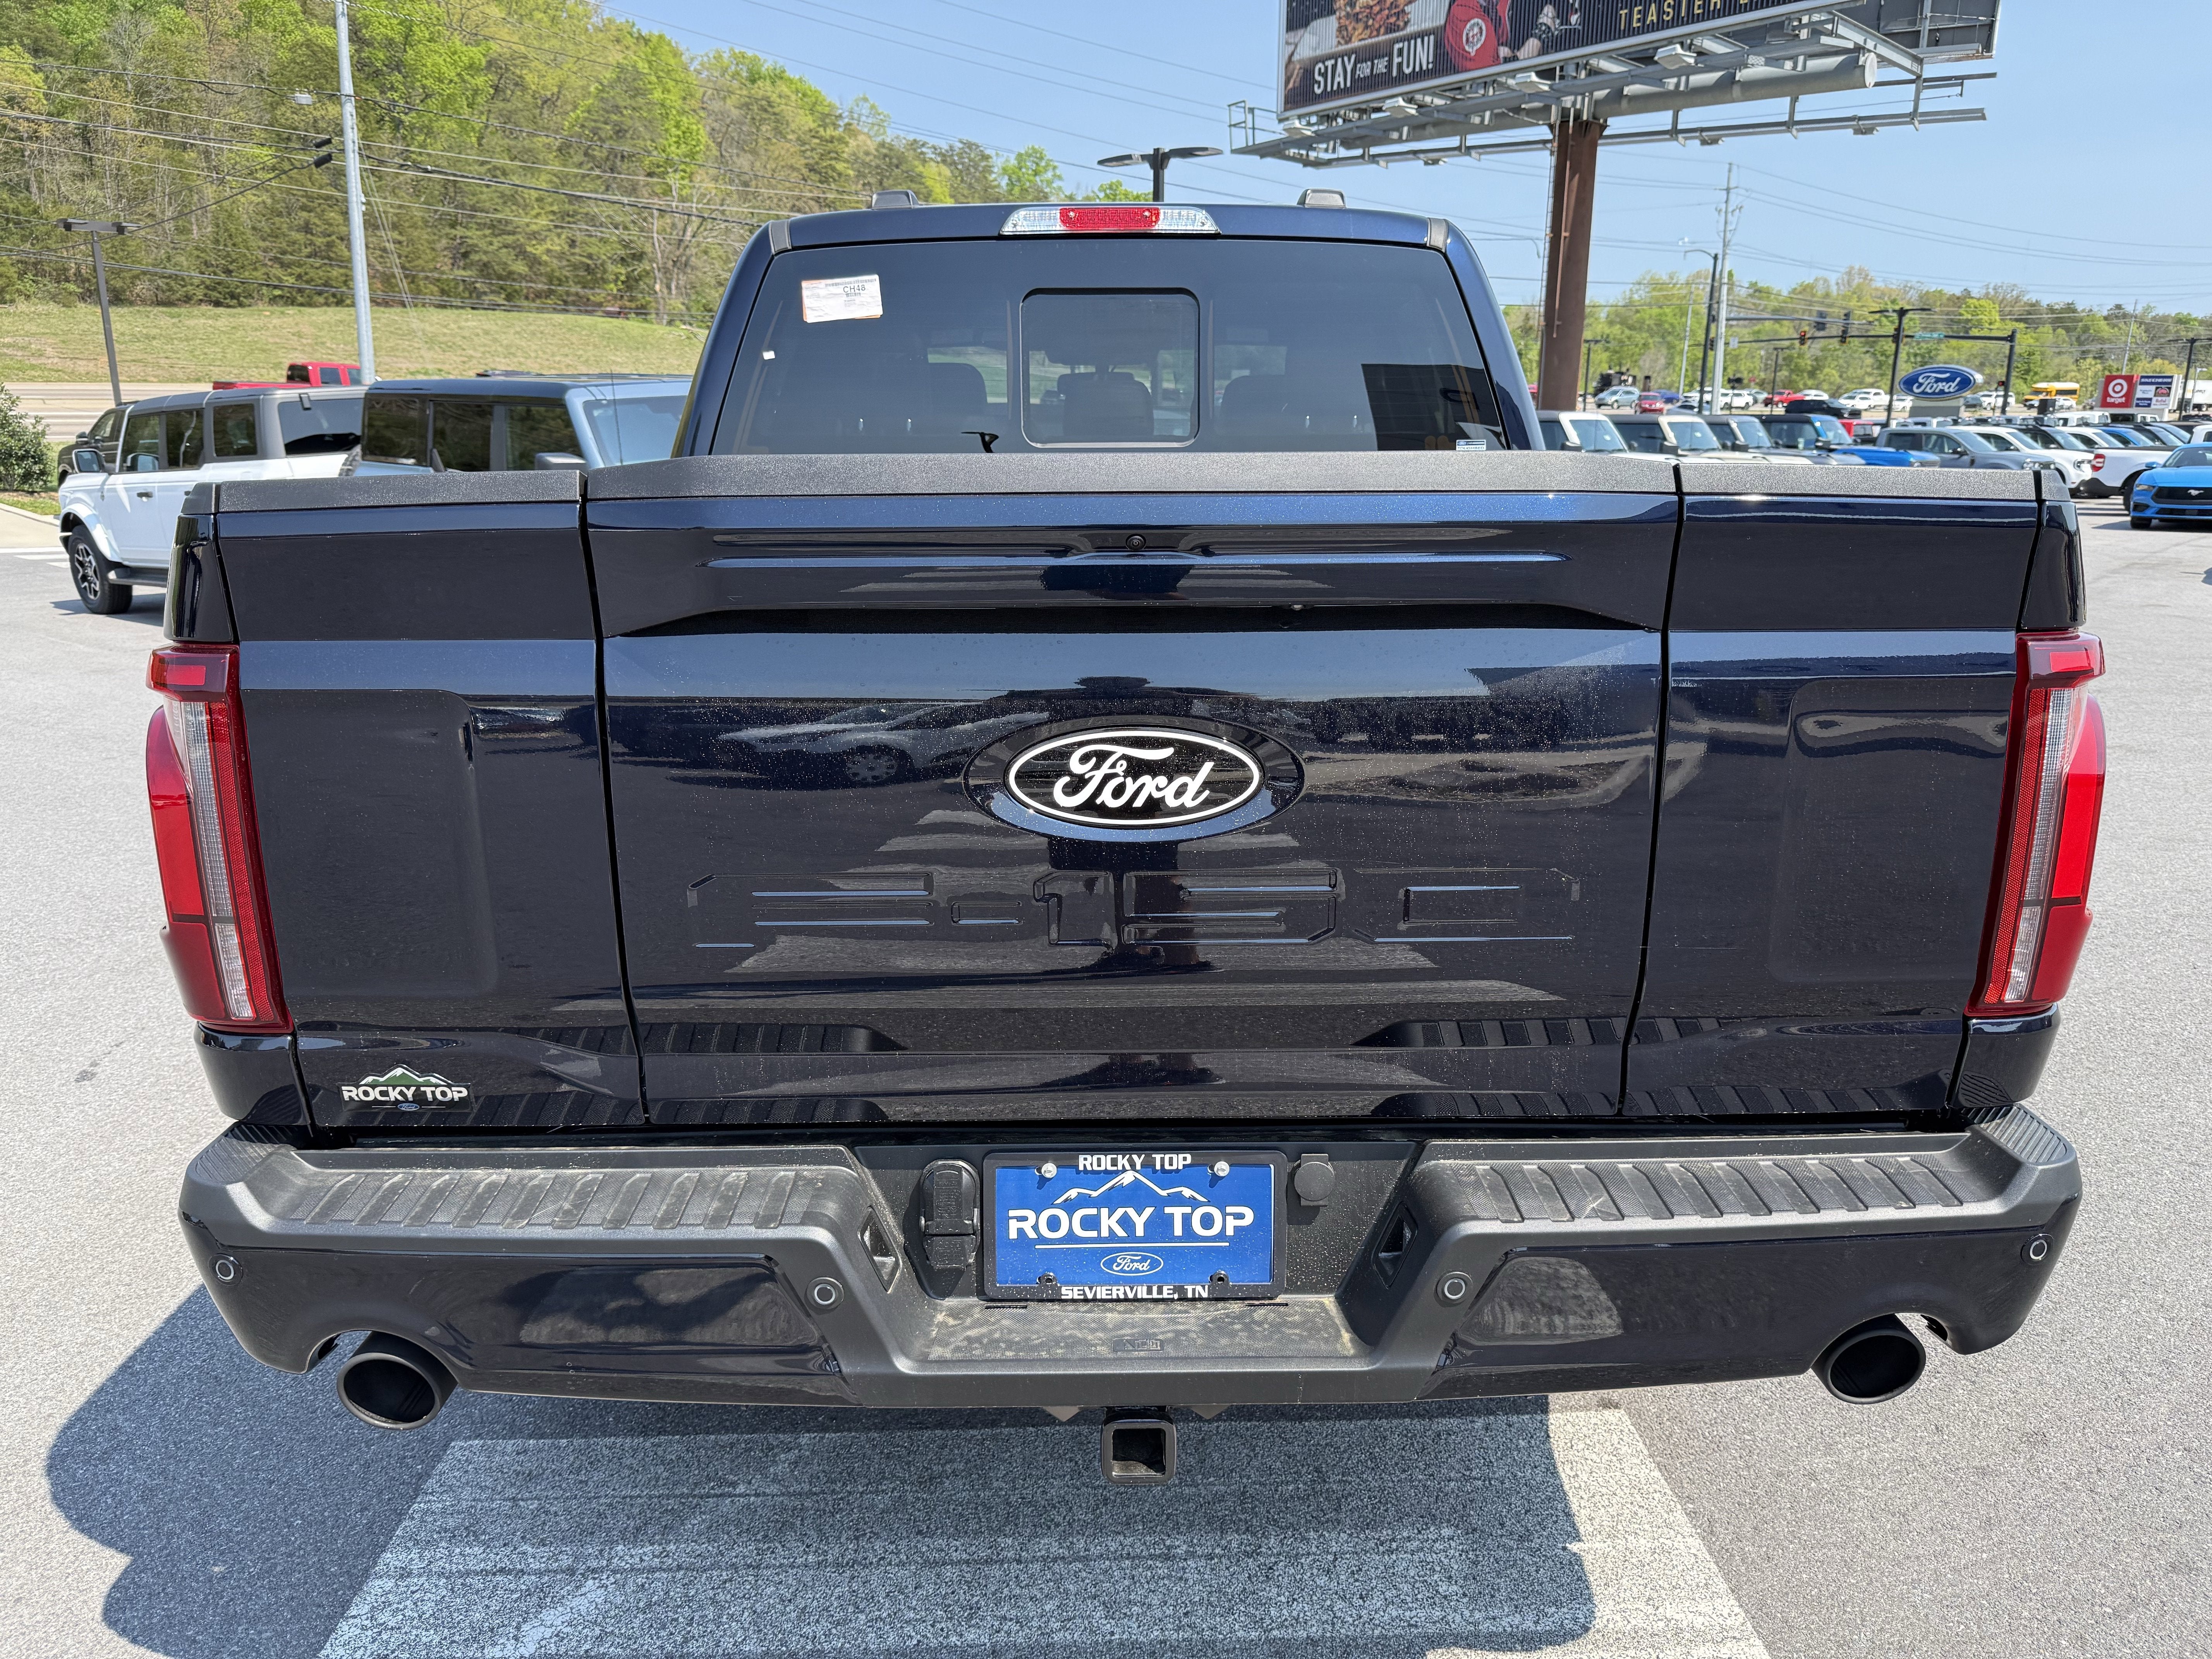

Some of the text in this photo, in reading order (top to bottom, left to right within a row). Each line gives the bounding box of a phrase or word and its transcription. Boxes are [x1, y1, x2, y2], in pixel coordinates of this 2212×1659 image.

[1314, 53, 1356, 94] STAY
[1355, 61, 1372, 79] FOR
[1373, 57, 1389, 75] THE
[1392, 34, 1435, 77] FUN!
[843, 284, 866, 293] CH48
[1912, 373, 1961, 393] Ford
[1053, 744, 1215, 808] Ford
[341, 1086, 468, 1101] ROCKY TOP
[1079, 1154, 1192, 1171] ROCKY TOP
[1008, 1206, 1255, 1239] ROCKY TOP
[1112, 1255, 1150, 1271] Ford
[1061, 1285, 1209, 1300] SEVIERVILLE, TN
